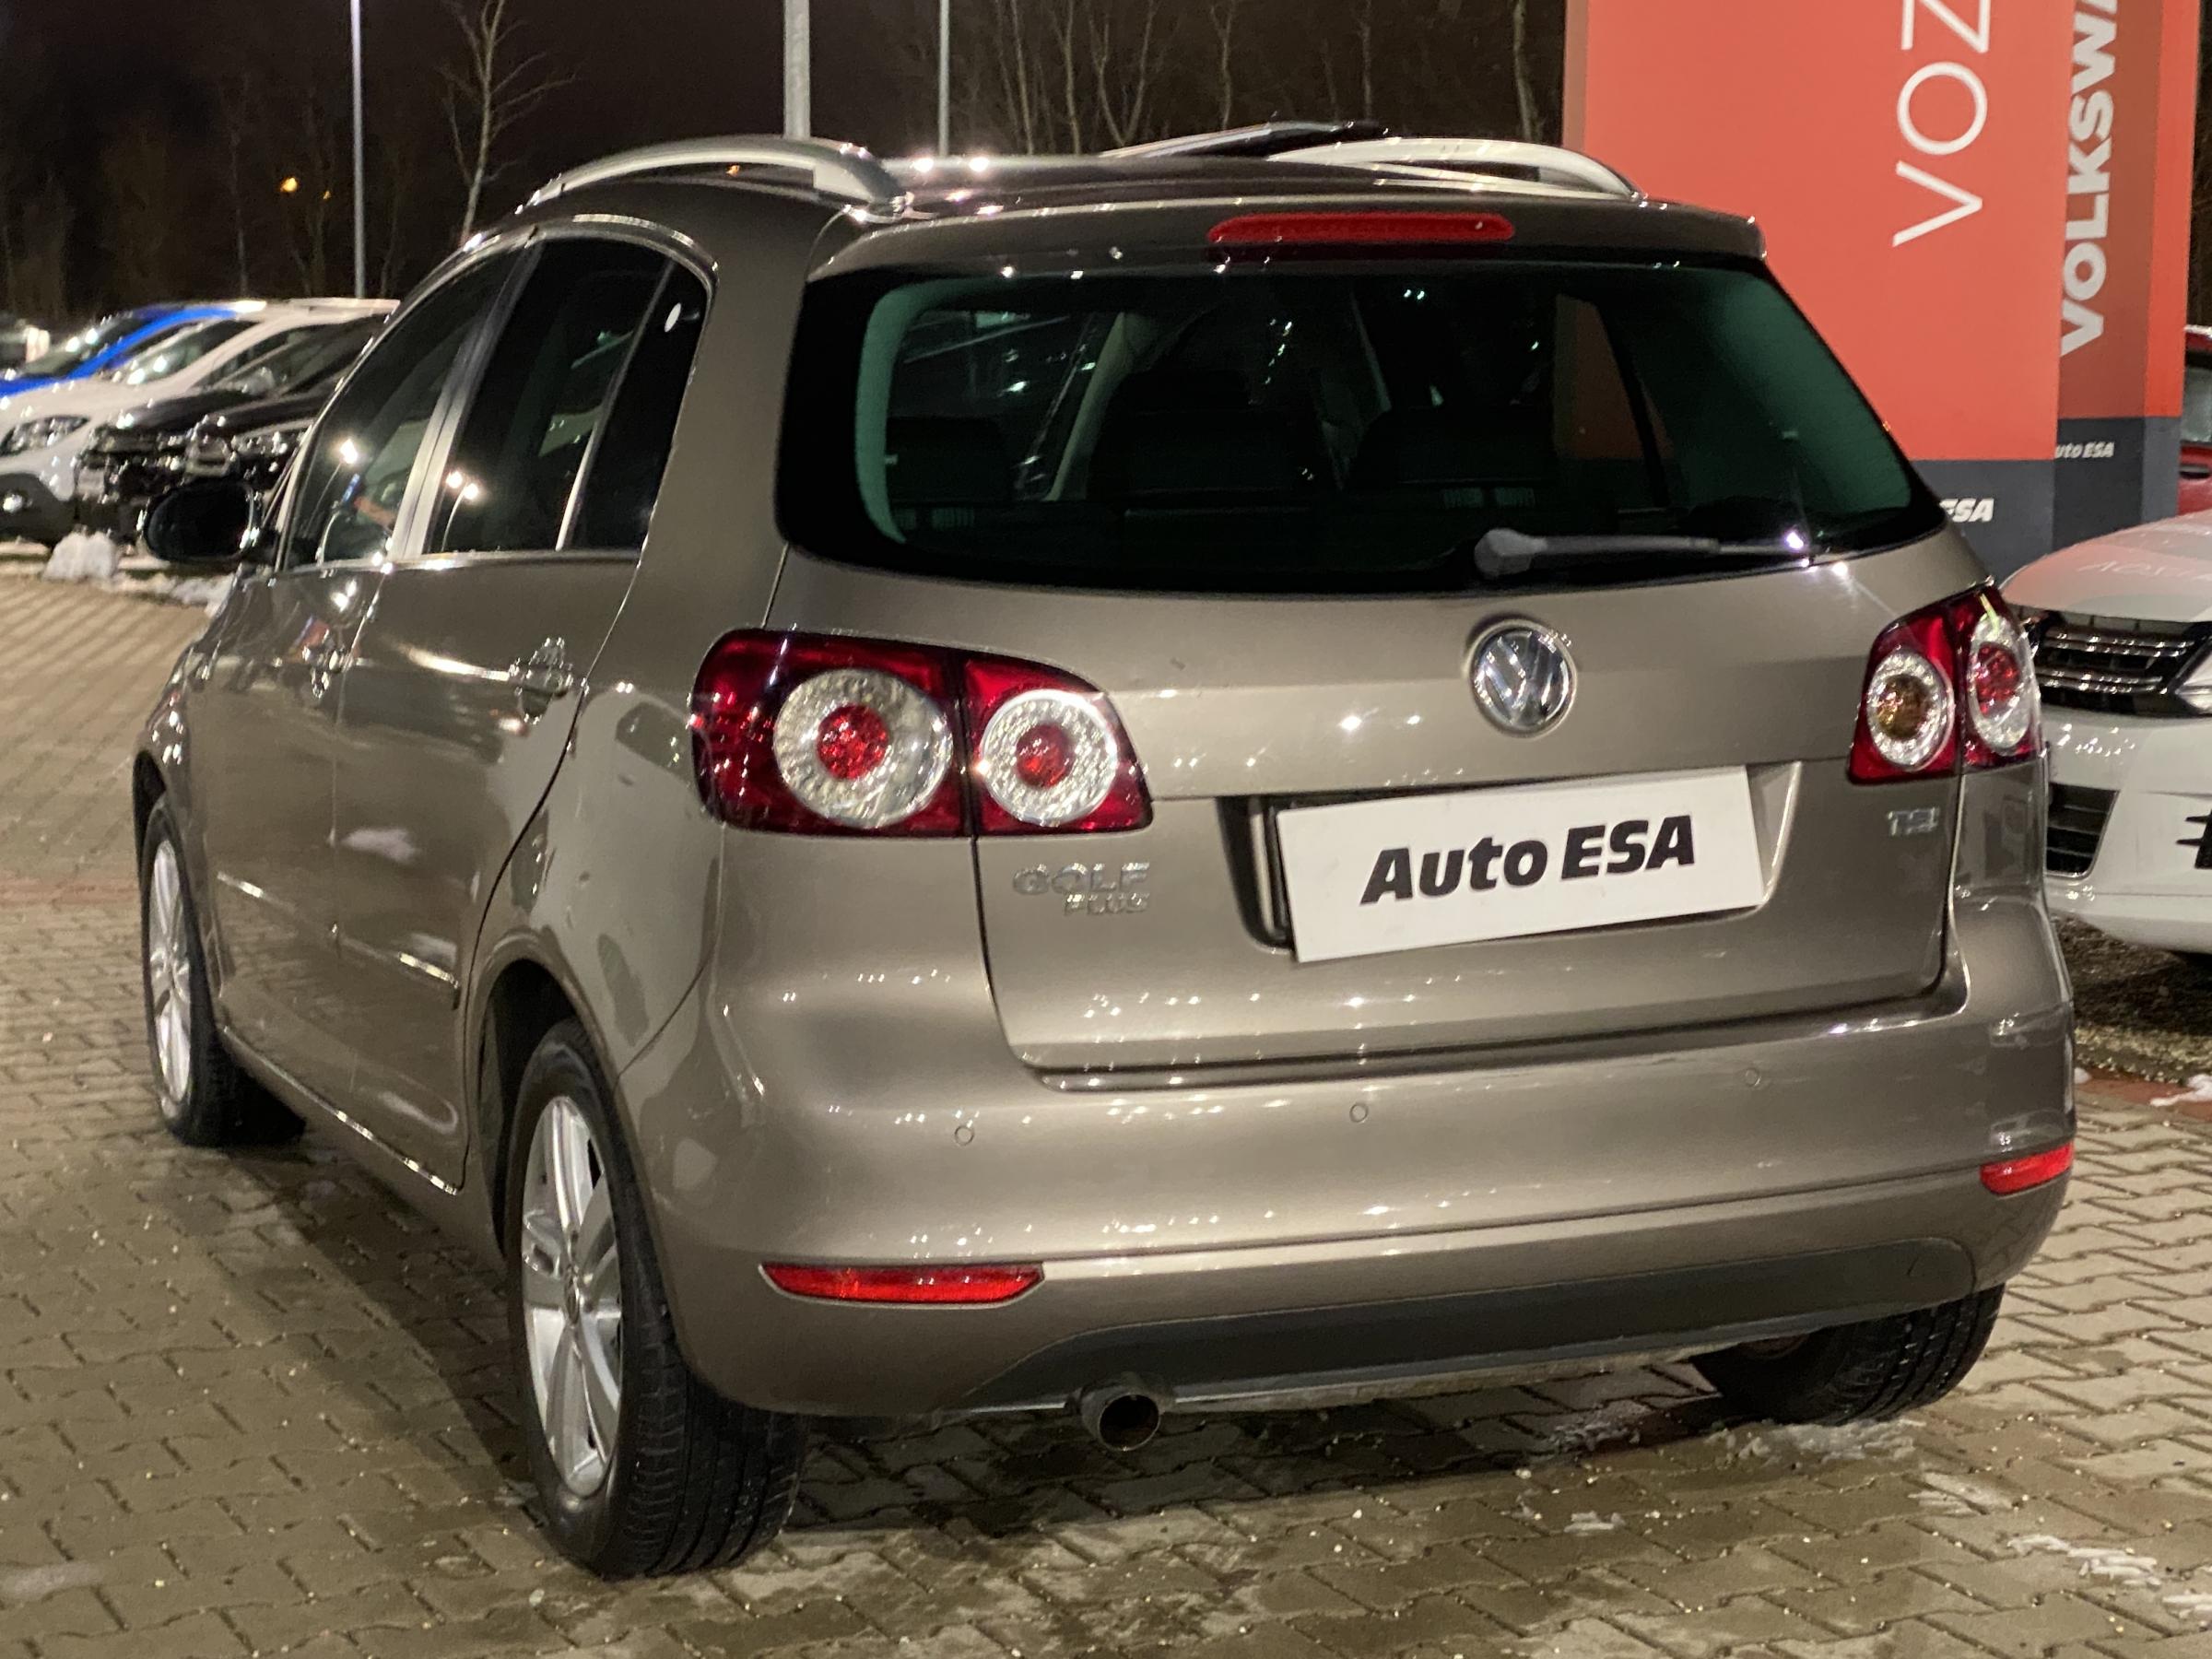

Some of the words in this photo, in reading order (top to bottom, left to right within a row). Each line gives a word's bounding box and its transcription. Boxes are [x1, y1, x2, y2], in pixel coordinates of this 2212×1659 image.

[2054, 442, 2083, 459] uto
[2082, 441, 2115, 458] ESA
[1359, 836, 1548, 906] Auto
[1561, 814, 1695, 881] ESA
[1013, 862, 1149, 896] GOLF
